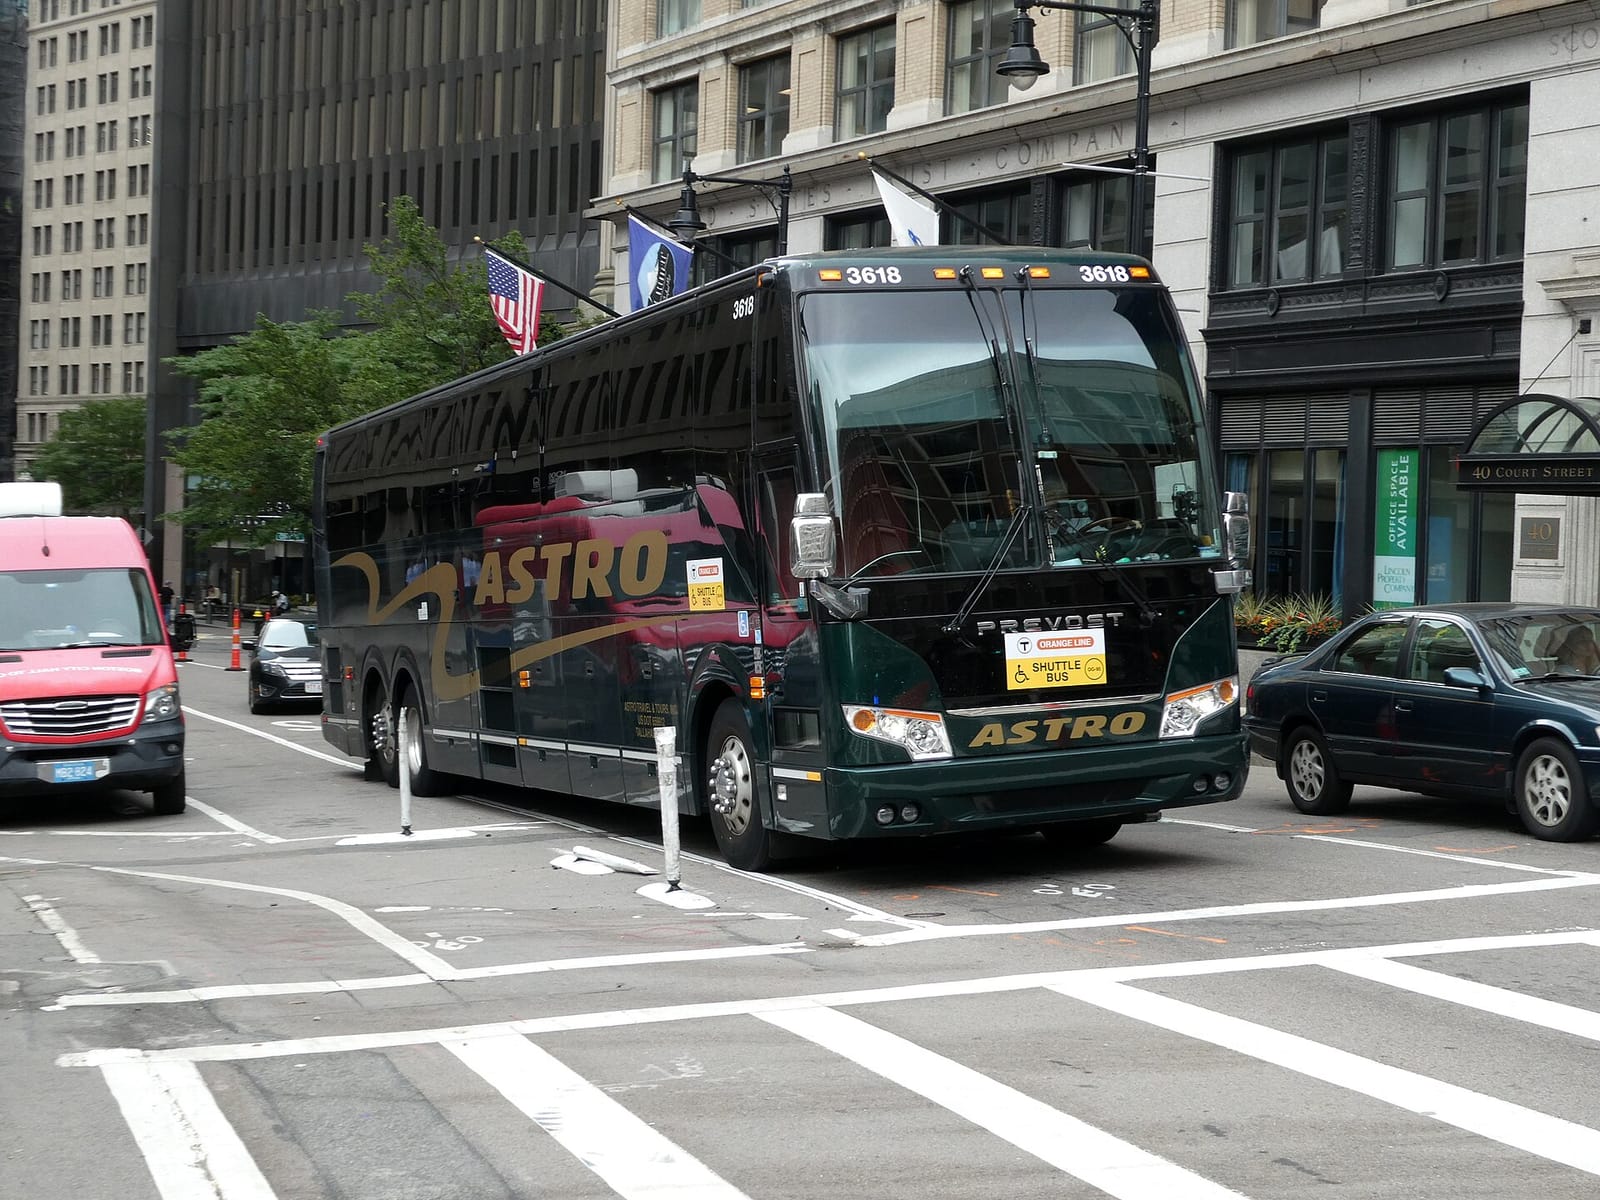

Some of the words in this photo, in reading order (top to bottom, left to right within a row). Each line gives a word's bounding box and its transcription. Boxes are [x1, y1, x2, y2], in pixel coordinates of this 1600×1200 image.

[995, 121, 1125, 170] COMPAN
[846, 266, 902, 285] 3618
[1079, 265, 1130, 283] 3618
[733, 295, 754, 320] 3618
[1390, 460, 1399, 497] SPACE
[1472, 466, 1491, 480] 40
[1495, 467, 1537, 478] COURT
[1543, 467, 1594, 478] STREET
[1397, 455, 1409, 550] AVAILABLE
[1389, 501, 1397, 542] OFFICE
[1527, 522, 1552, 541] 40
[473, 529, 668, 606] ASTRO
[697, 587, 715, 597] SHUTTLE
[977, 612, 1124, 636] PREVOST
[1020, 641, 1029, 651] T
[1039, 638, 1073, 649] ORANGE
[1074, 637, 1092, 647] LINE
[1032, 660, 1081, 673] SHUTTLE
[1046, 672, 1069, 682] BUS
[968, 711, 1146, 748] ASTRO
